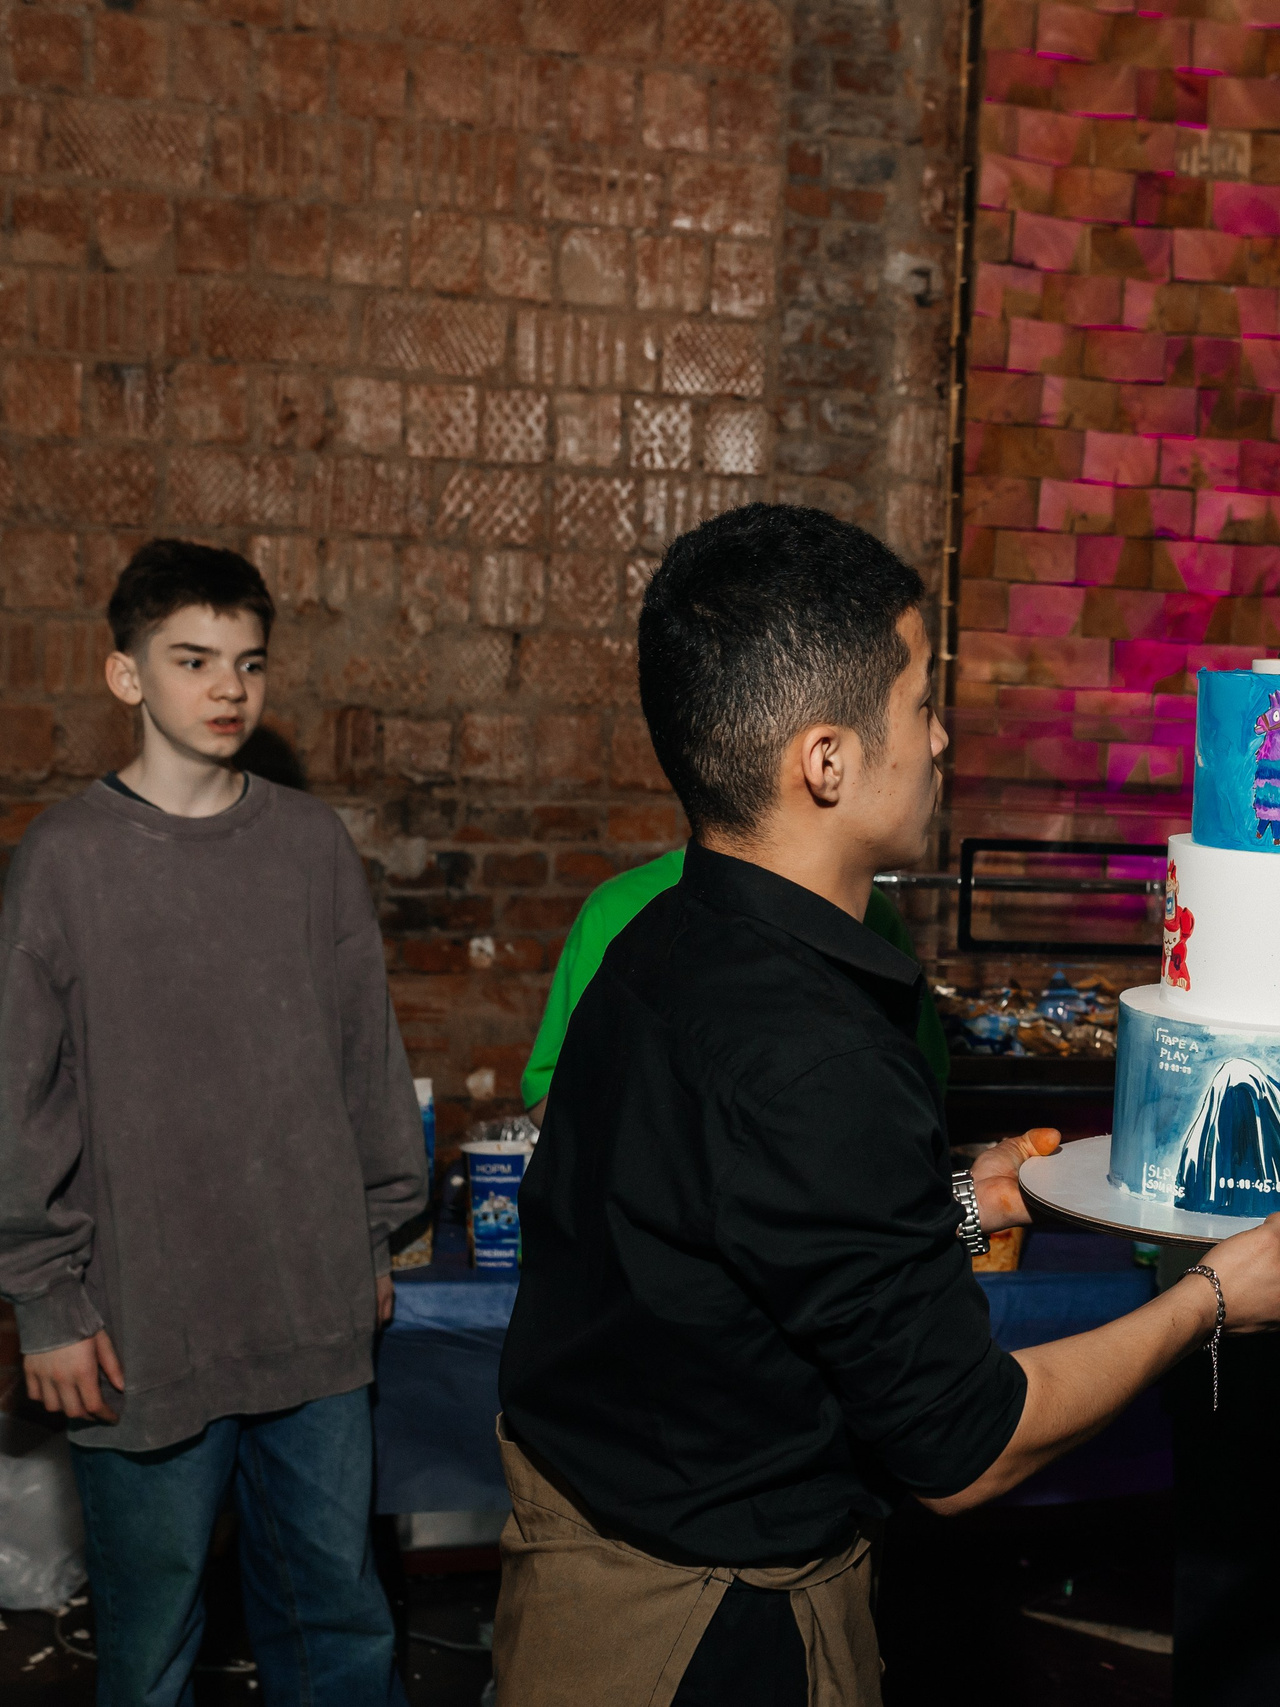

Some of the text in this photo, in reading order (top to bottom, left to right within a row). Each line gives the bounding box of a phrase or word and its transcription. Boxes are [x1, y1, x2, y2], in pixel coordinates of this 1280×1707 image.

[1160, 1034, 1199, 1054] TAPE A
[1159, 1047, 1190, 1065] PLAY
